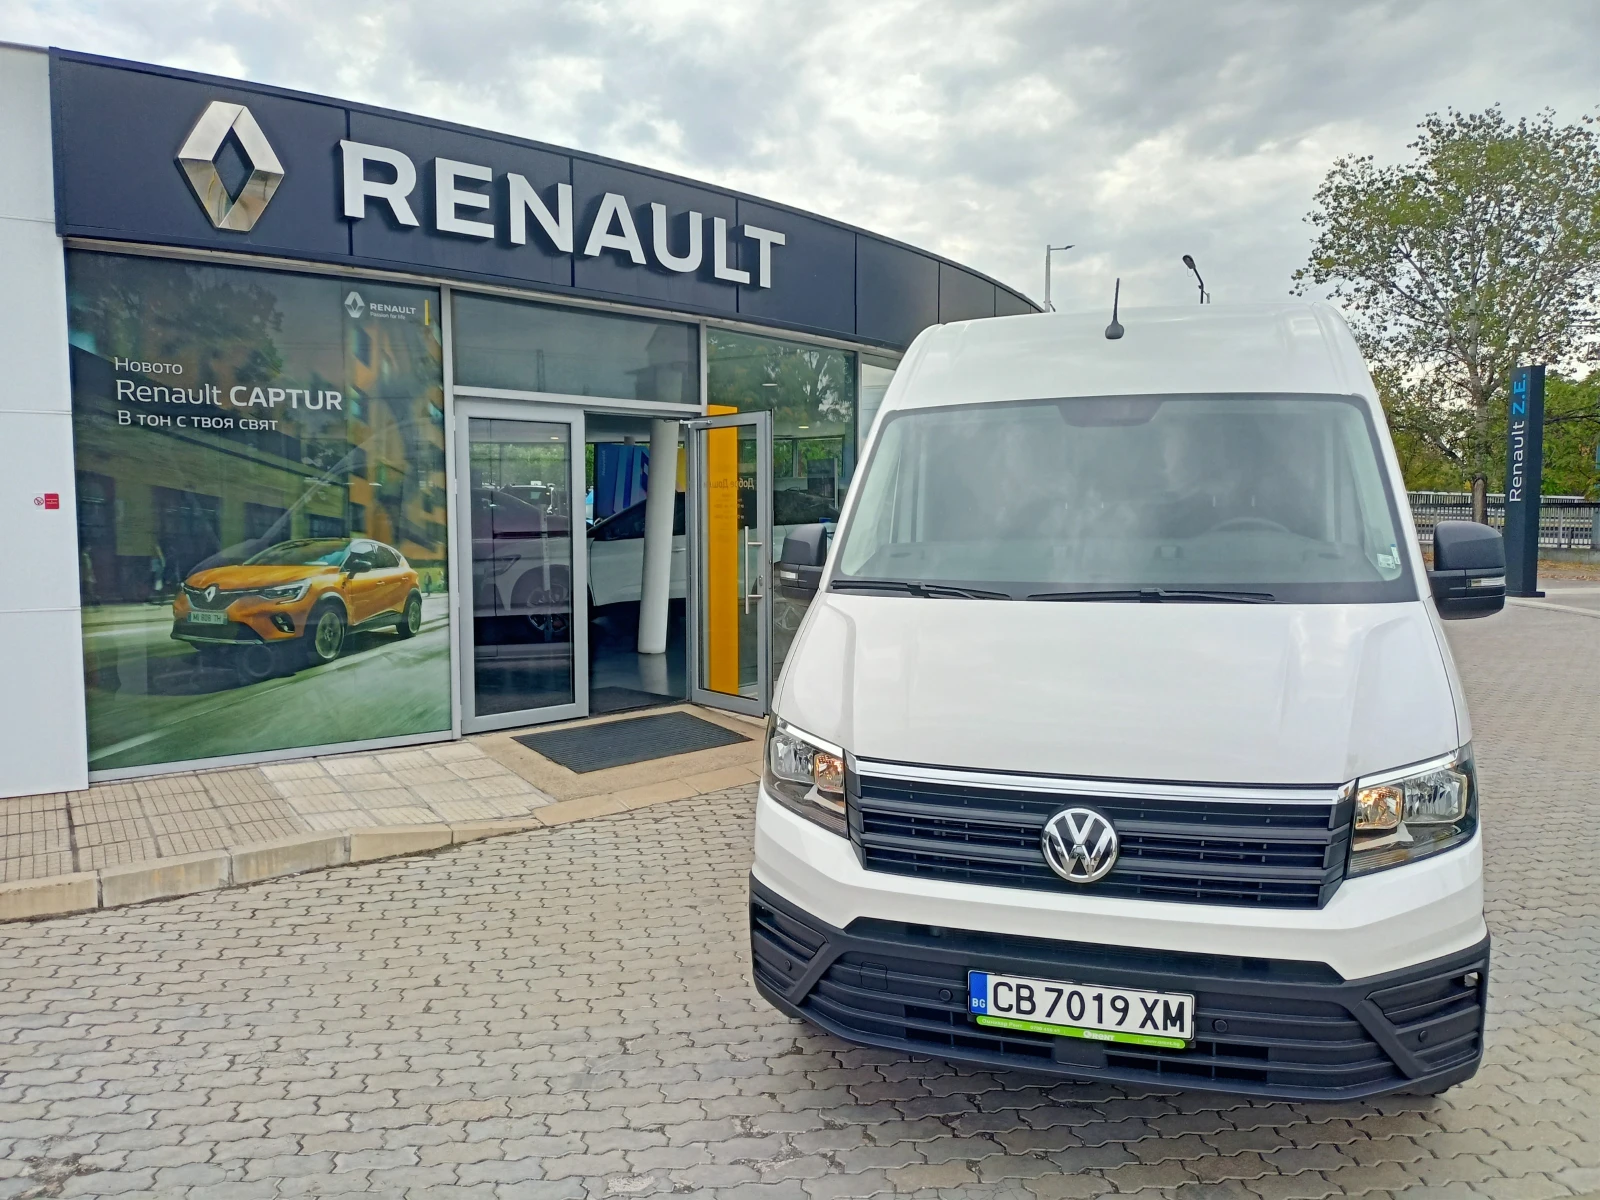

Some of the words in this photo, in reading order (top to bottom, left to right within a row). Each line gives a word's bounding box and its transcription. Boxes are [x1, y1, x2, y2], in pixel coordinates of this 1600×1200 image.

[339, 139, 786, 289] RENAULT
[370, 303, 416, 315] RENAULT
[370, 311, 389, 319] Passion
[114, 356, 183, 375] Новото
[116, 379, 222, 406] Renault
[229, 385, 343, 411] CAPTUR
[1512, 373, 1526, 415] Z.E.
[117, 409, 132, 426] В
[136, 413, 171, 427] тон
[176, 415, 187, 428] с
[191, 416, 234, 429] твоя
[239, 418, 278, 431] свят
[1509, 421, 1525, 502] Renault
[1042, 808, 1117, 884] VW
[972, 998, 986, 1008] BG
[993, 981, 1036, 1016] CB
[1044, 987, 1130, 1026] 7019
[1139, 997, 1185, 1033] XM
